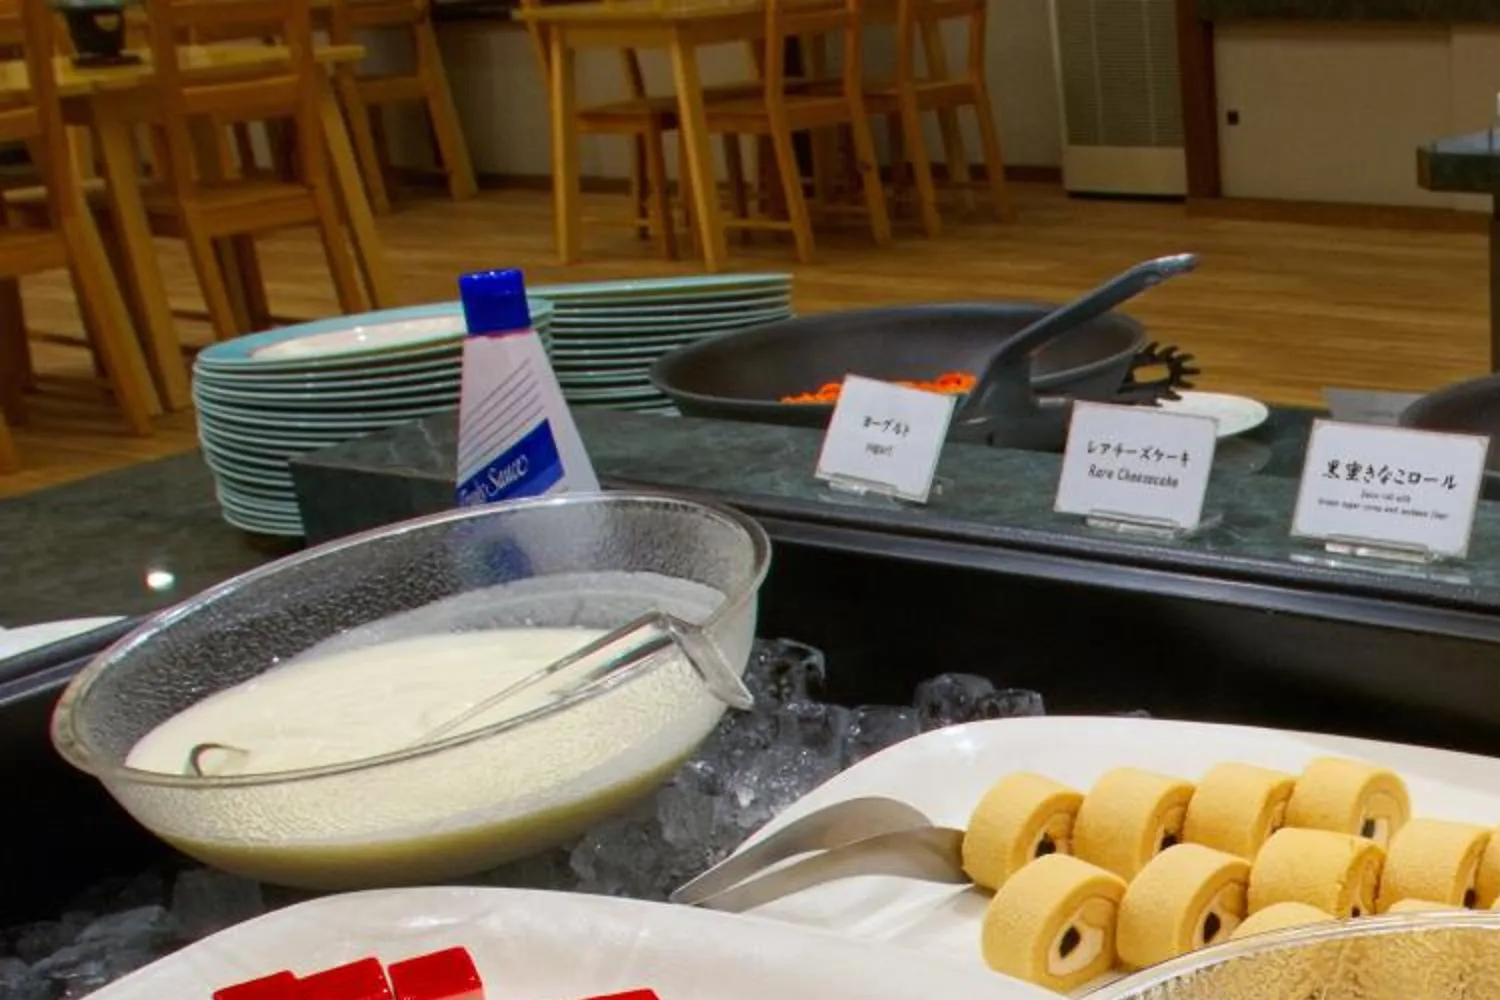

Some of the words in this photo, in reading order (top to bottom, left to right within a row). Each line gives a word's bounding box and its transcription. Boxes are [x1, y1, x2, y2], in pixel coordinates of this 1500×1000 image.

[1087, 440, 1190, 468] レアチーズケーキ
[1088, 464, 1114, 480] Rare
